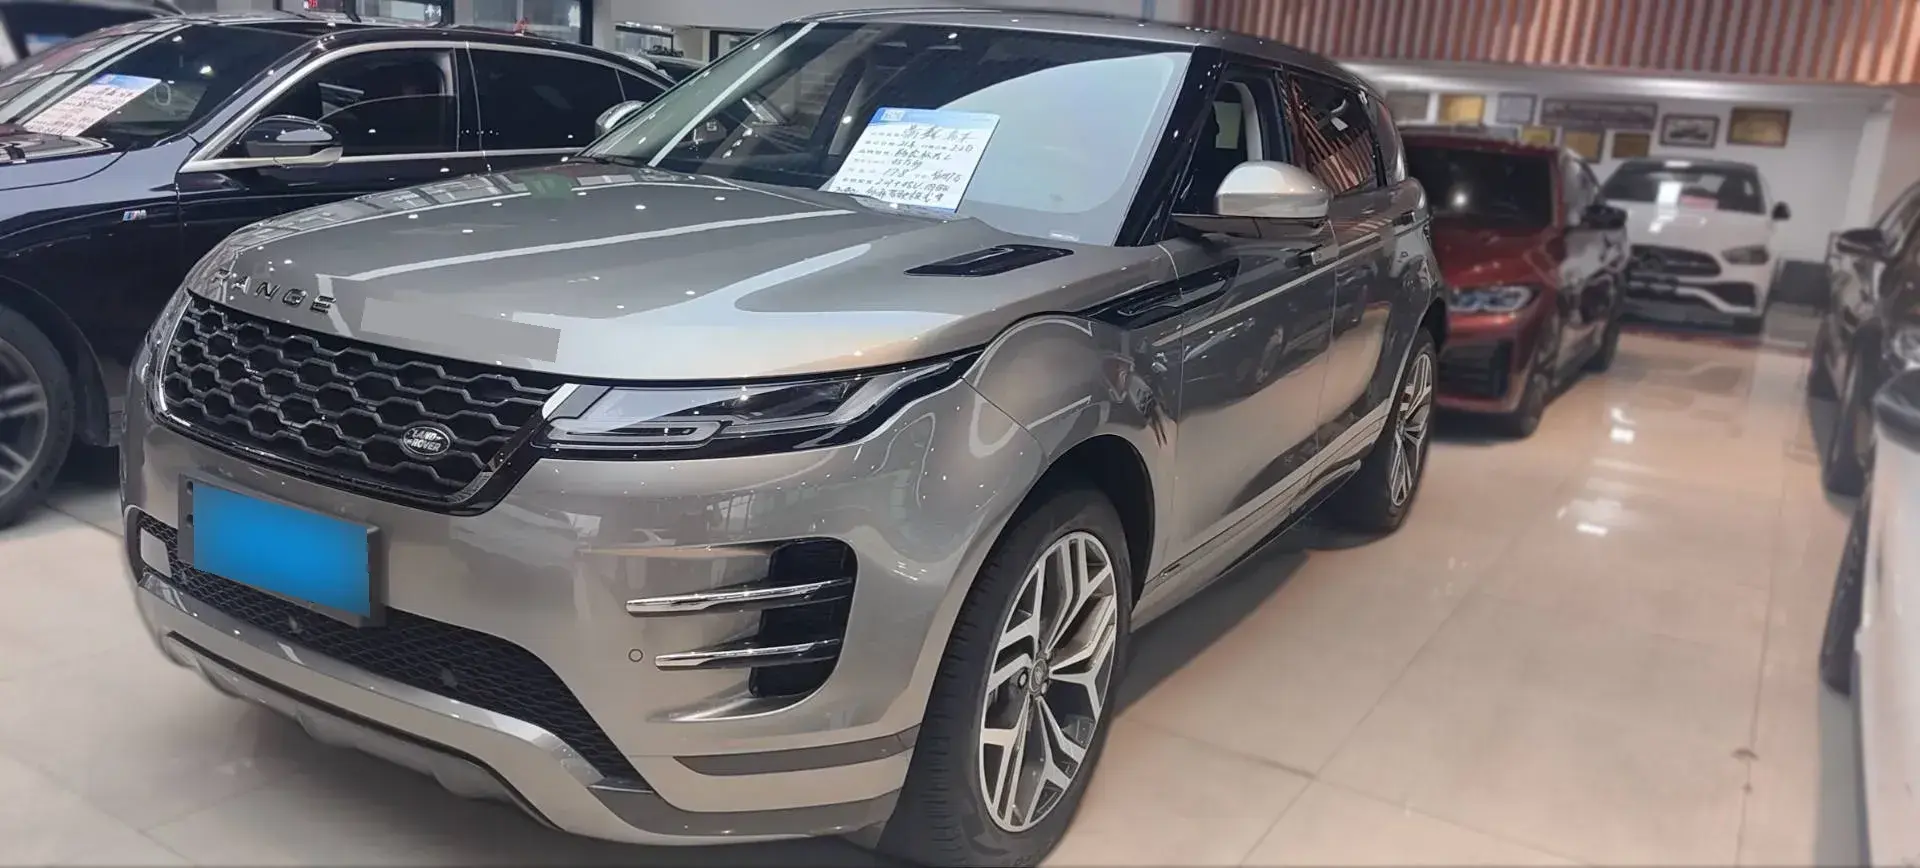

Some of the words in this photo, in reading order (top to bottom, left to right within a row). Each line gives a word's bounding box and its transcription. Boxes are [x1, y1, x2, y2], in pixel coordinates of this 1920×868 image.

[211, 268, 337, 314] RANGE
[411, 429, 437, 441] LAND
[411, 438, 441, 452] ROVER
